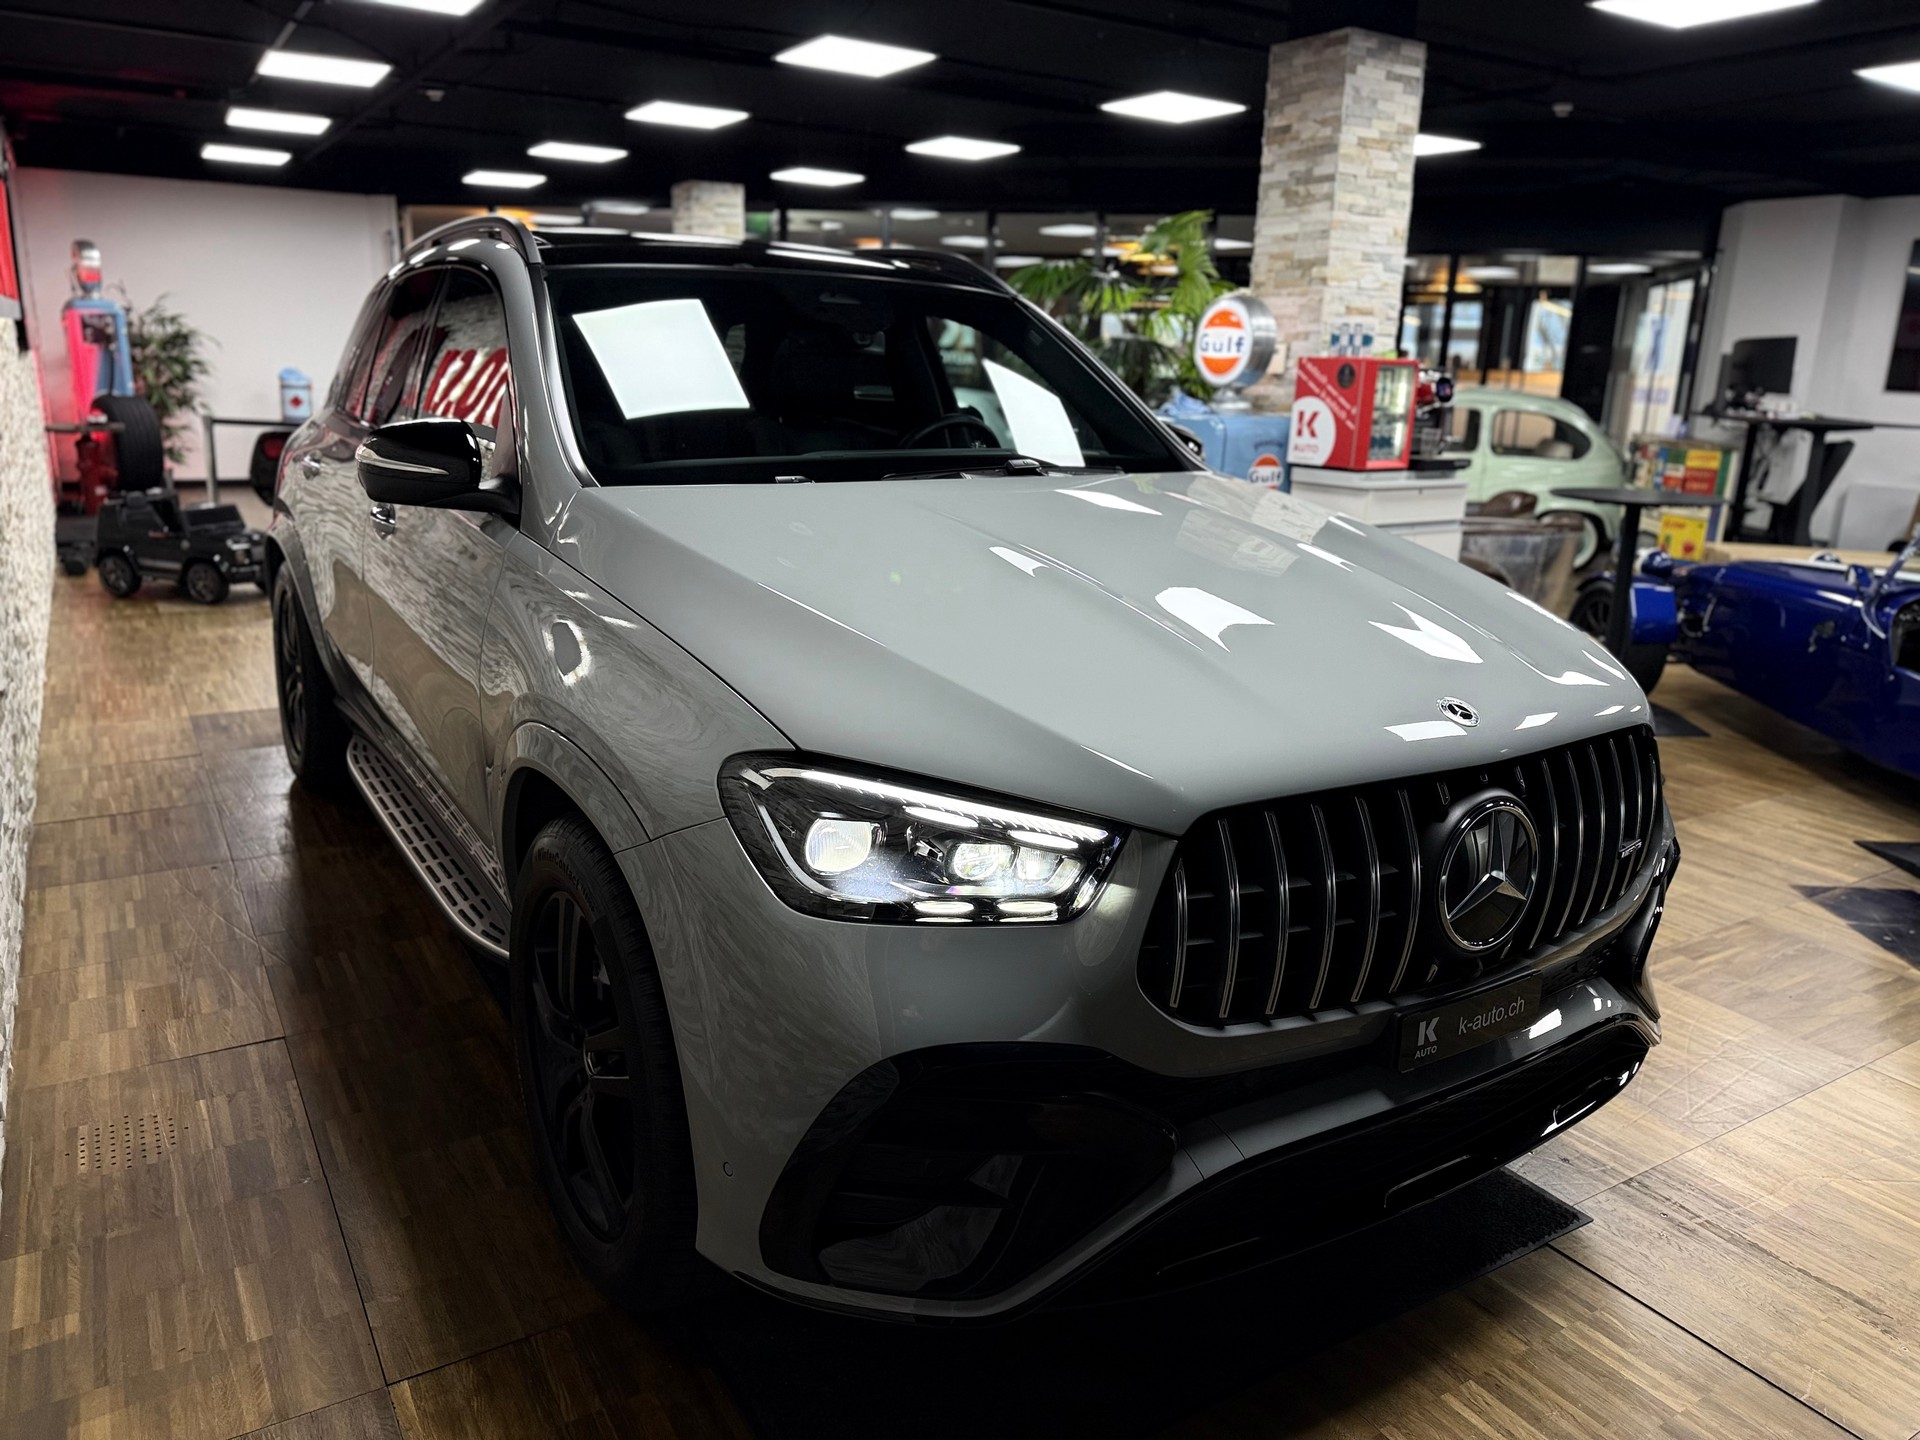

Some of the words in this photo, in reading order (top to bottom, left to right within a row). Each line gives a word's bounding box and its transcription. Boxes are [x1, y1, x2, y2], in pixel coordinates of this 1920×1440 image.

[1200, 333, 1245, 353] Gulf
[1297, 410, 1320, 438] K
[1250, 470, 1282, 484] Gulf
[1458, 996, 1525, 1036] k-auto.ch
[1417, 1016, 1440, 1047] K
[1414, 1045, 1438, 1060] AUTO
